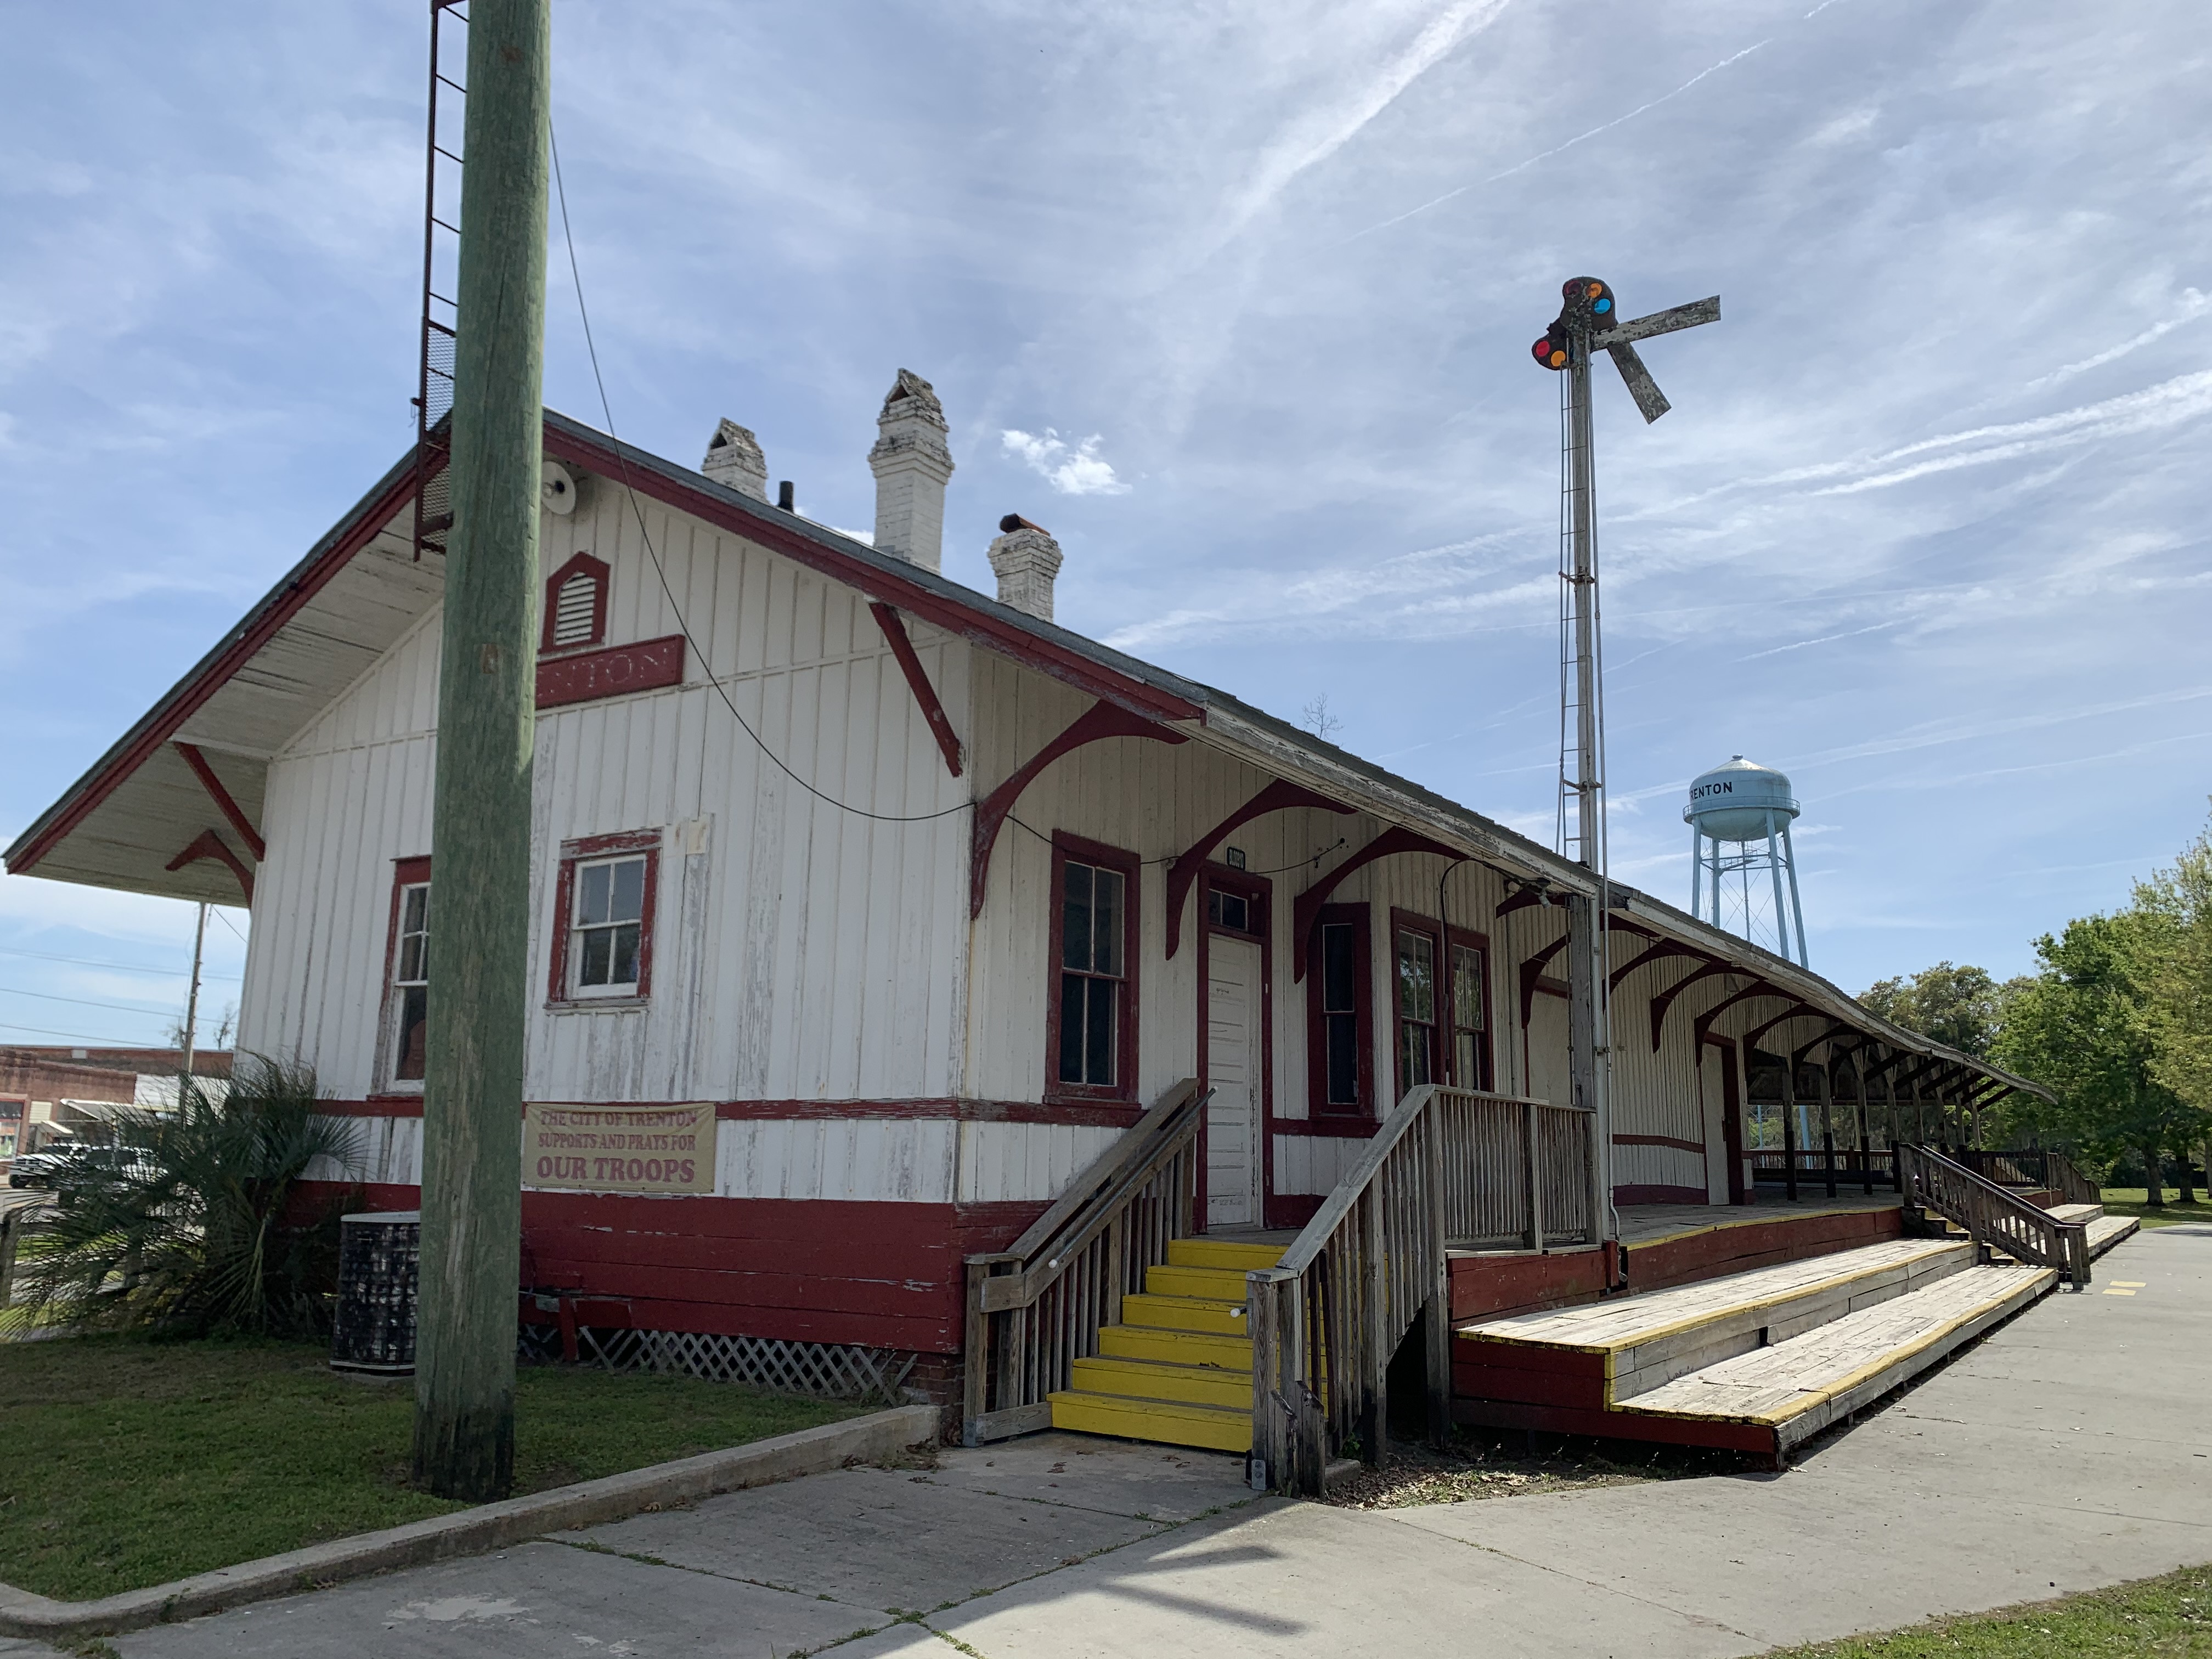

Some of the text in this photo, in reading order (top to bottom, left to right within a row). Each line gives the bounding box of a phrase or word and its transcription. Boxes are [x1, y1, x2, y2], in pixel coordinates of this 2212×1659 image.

[540, 1111, 697, 1127] THE CITY OF TRENTON
[538, 1133, 696, 1150] SUPPORTS AND PRAYS FOR
[537, 1156, 695, 1183] OUR TROOPS
